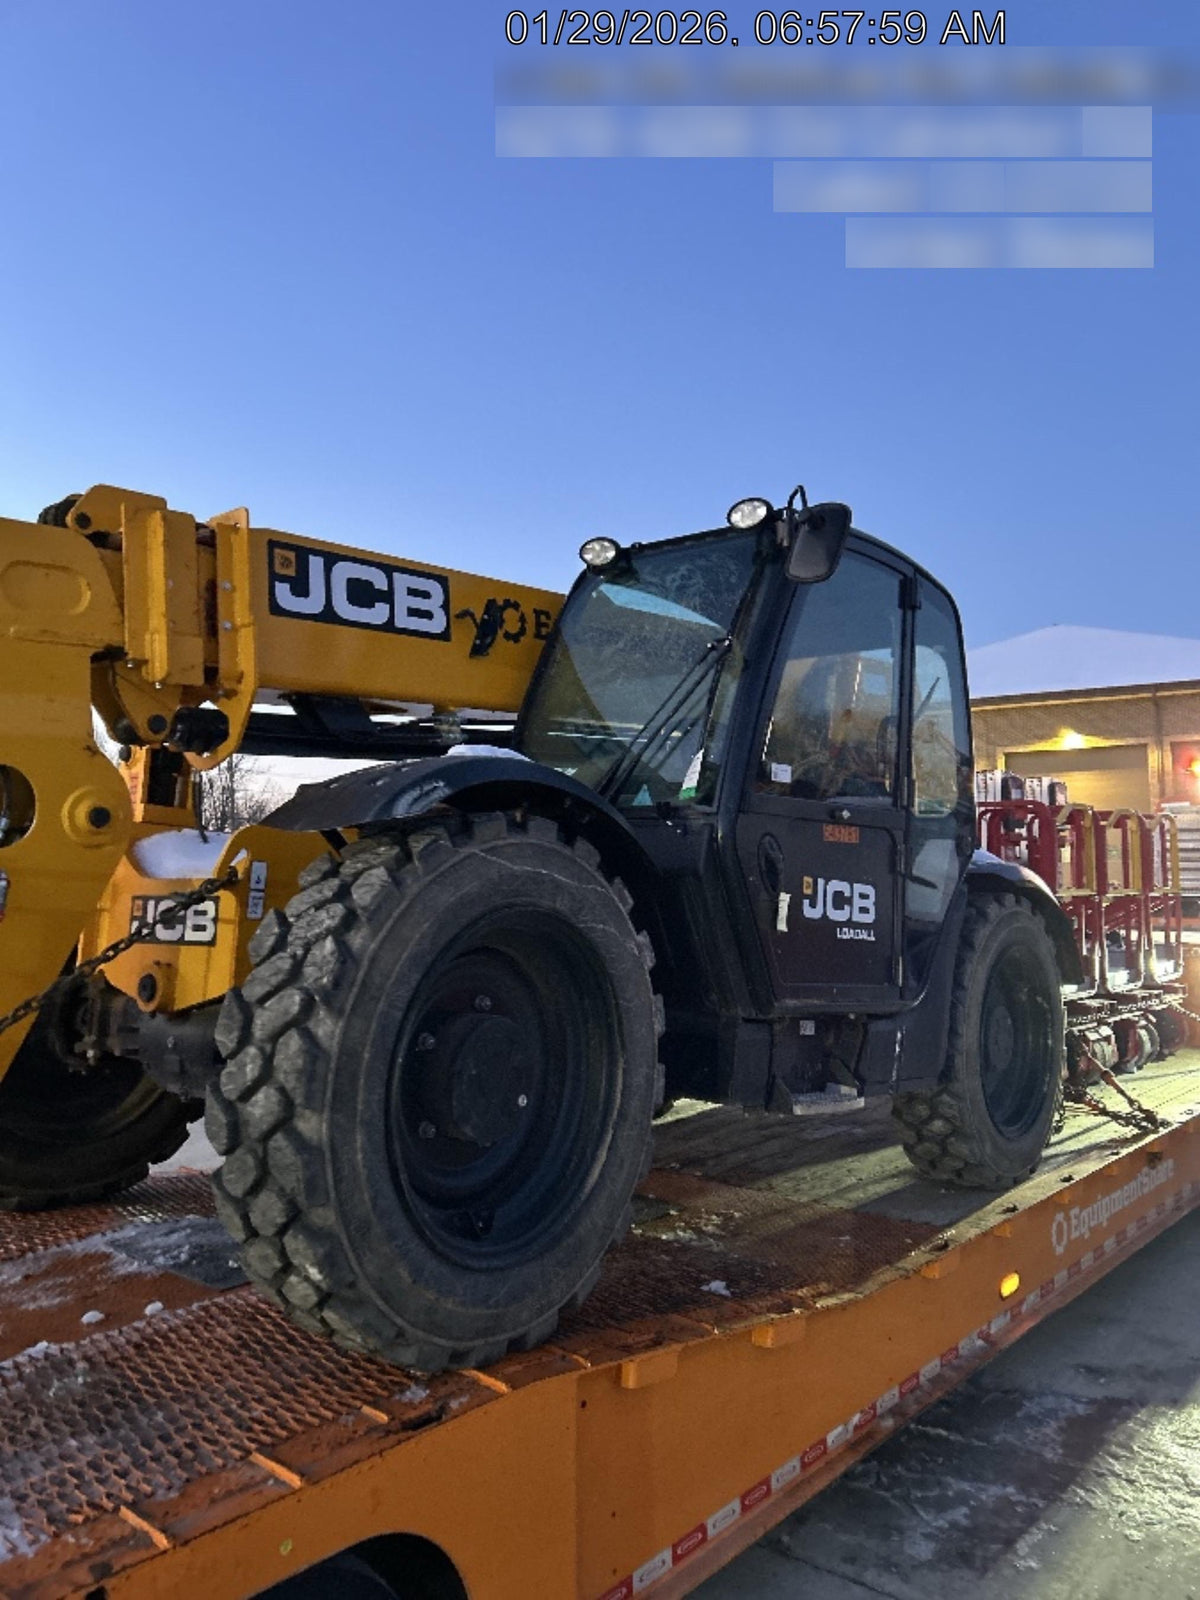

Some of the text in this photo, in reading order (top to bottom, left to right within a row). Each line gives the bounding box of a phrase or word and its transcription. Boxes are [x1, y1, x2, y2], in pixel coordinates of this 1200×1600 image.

[274, 554, 448, 634] JCB
[803, 877, 876, 924] JCB
[836, 927, 876, 942] LOADALL
